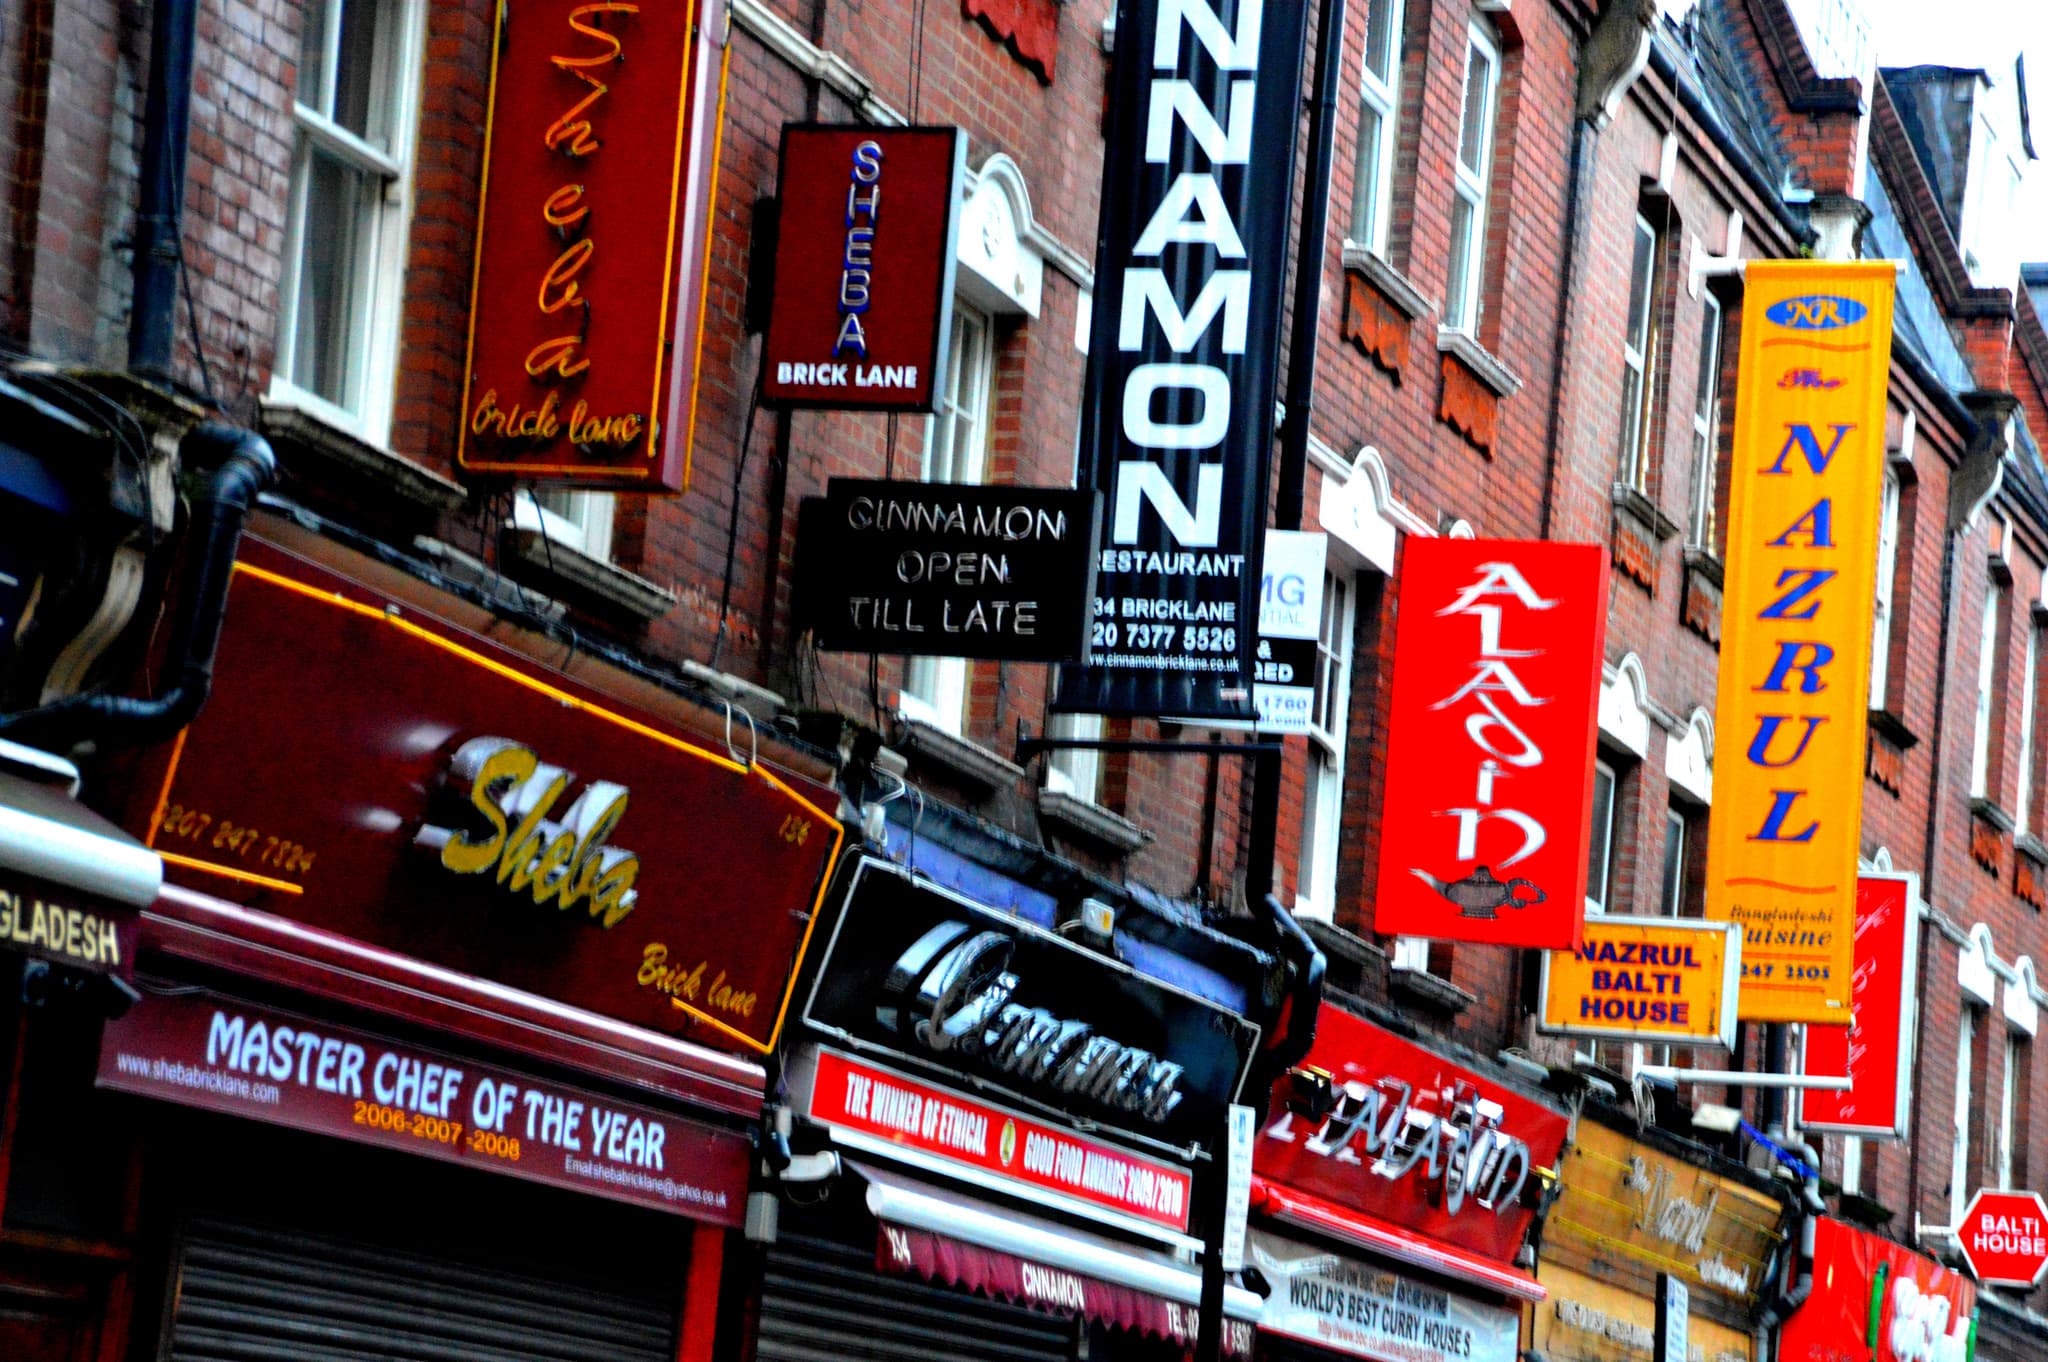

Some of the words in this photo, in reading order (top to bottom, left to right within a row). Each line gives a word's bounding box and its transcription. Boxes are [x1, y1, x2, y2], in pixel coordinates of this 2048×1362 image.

[832, 140, 882, 358] SHEBA
[777, 363, 847, 387] BRICK
[855, 365, 917, 389] LANE
[1777, 367, 1847, 391] The
[568, 401, 642, 446] lane
[848, 496, 1066, 541] CINNAMON
[897, 550, 1013, 586] OPEN
[1097, 549, 1245, 577] ESTAURANT
[850, 597, 925, 633] TILL
[943, 600, 1037, 636] LATE
[1121, 598, 1236, 622] BRICKLANE
[1092, 622, 1118, 648] 20
[1126, 623, 1175, 650] 7377
[1183, 626, 1236, 653] 5526
[1257, 639, 1272, 660] &
[1746, 423, 1858, 843] NAZRUL
[442, 748, 640, 929] Sheba
[1743, 922, 1832, 946] uisine
[1575, 941, 1701, 969] NAZRUL
[637, 942, 708, 1001] Brick
[708, 971, 757, 1018] lane
[1592, 970, 1683, 995] BALTI
[1580, 998, 1690, 1026] HOUSE
[207, 1010, 365, 1098] MASTER
[373, 1052, 464, 1118] CHEF
[472, 1078, 518, 1132] OF
[523, 1089, 584, 1151] THE
[591, 1107, 666, 1171] YEAR
[845, 1071, 871, 1119] THE
[870, 1080, 923, 1135] WINNER
[921, 1097, 940, 1140] OF
[938, 1103, 988, 1157] ETHICAL
[1024, 1130, 1056, 1176] GOOD
[1054, 1141, 1083, 1187] FOOD
[1082, 1150, 1127, 1200] AWARDS
[1981, 1214, 2041, 1234] BALTI
[1973, 1232, 2047, 1257] HOUSE
[1022, 1262, 1086, 1310] CINNAMON
[1290, 1275, 1344, 1320] WORLD'S
[1348, 1298, 1379, 1328] BEST
[1382, 1304, 1422, 1342] CURRY
